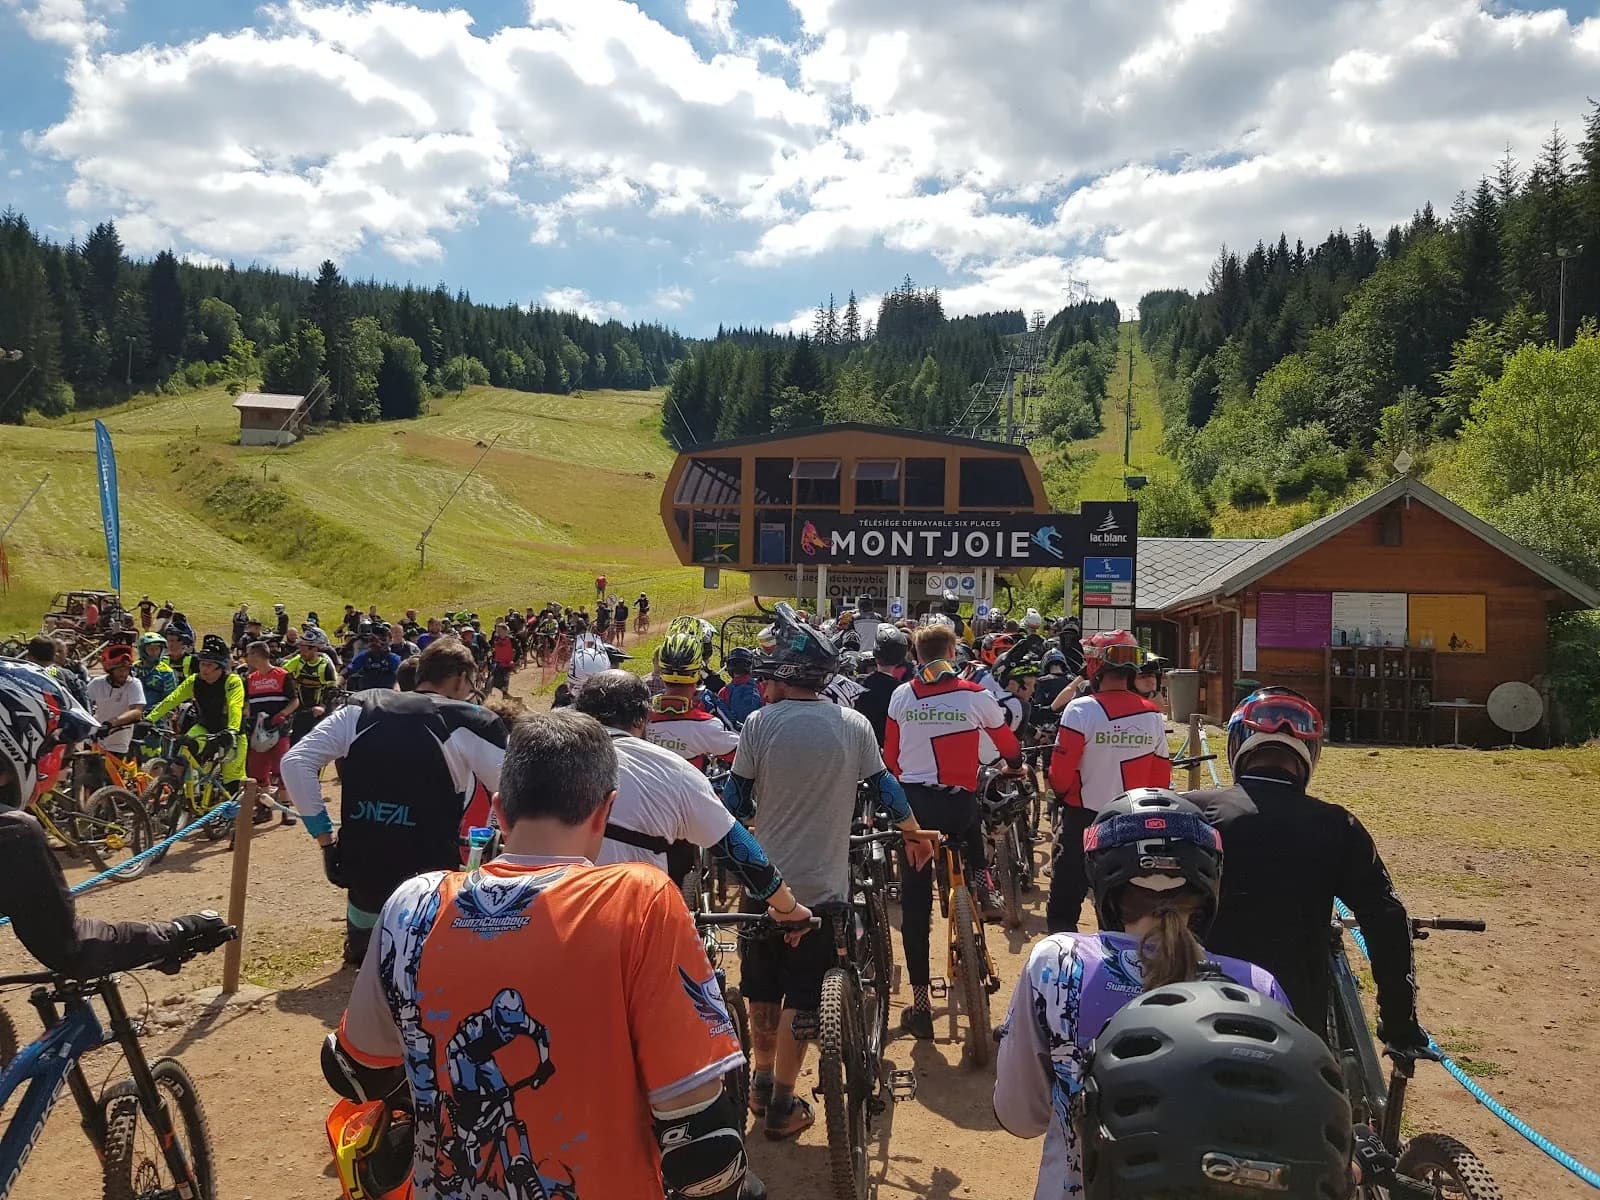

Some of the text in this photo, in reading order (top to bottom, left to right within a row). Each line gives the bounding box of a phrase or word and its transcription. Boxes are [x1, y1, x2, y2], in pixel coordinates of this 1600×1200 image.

[902, 519, 953, 527] DÉBRAYABLE
[1089, 532, 1129, 543] lac blanc
[830, 531, 1030, 558] MONTJOIE
[905, 708, 968, 722] BioFrais
